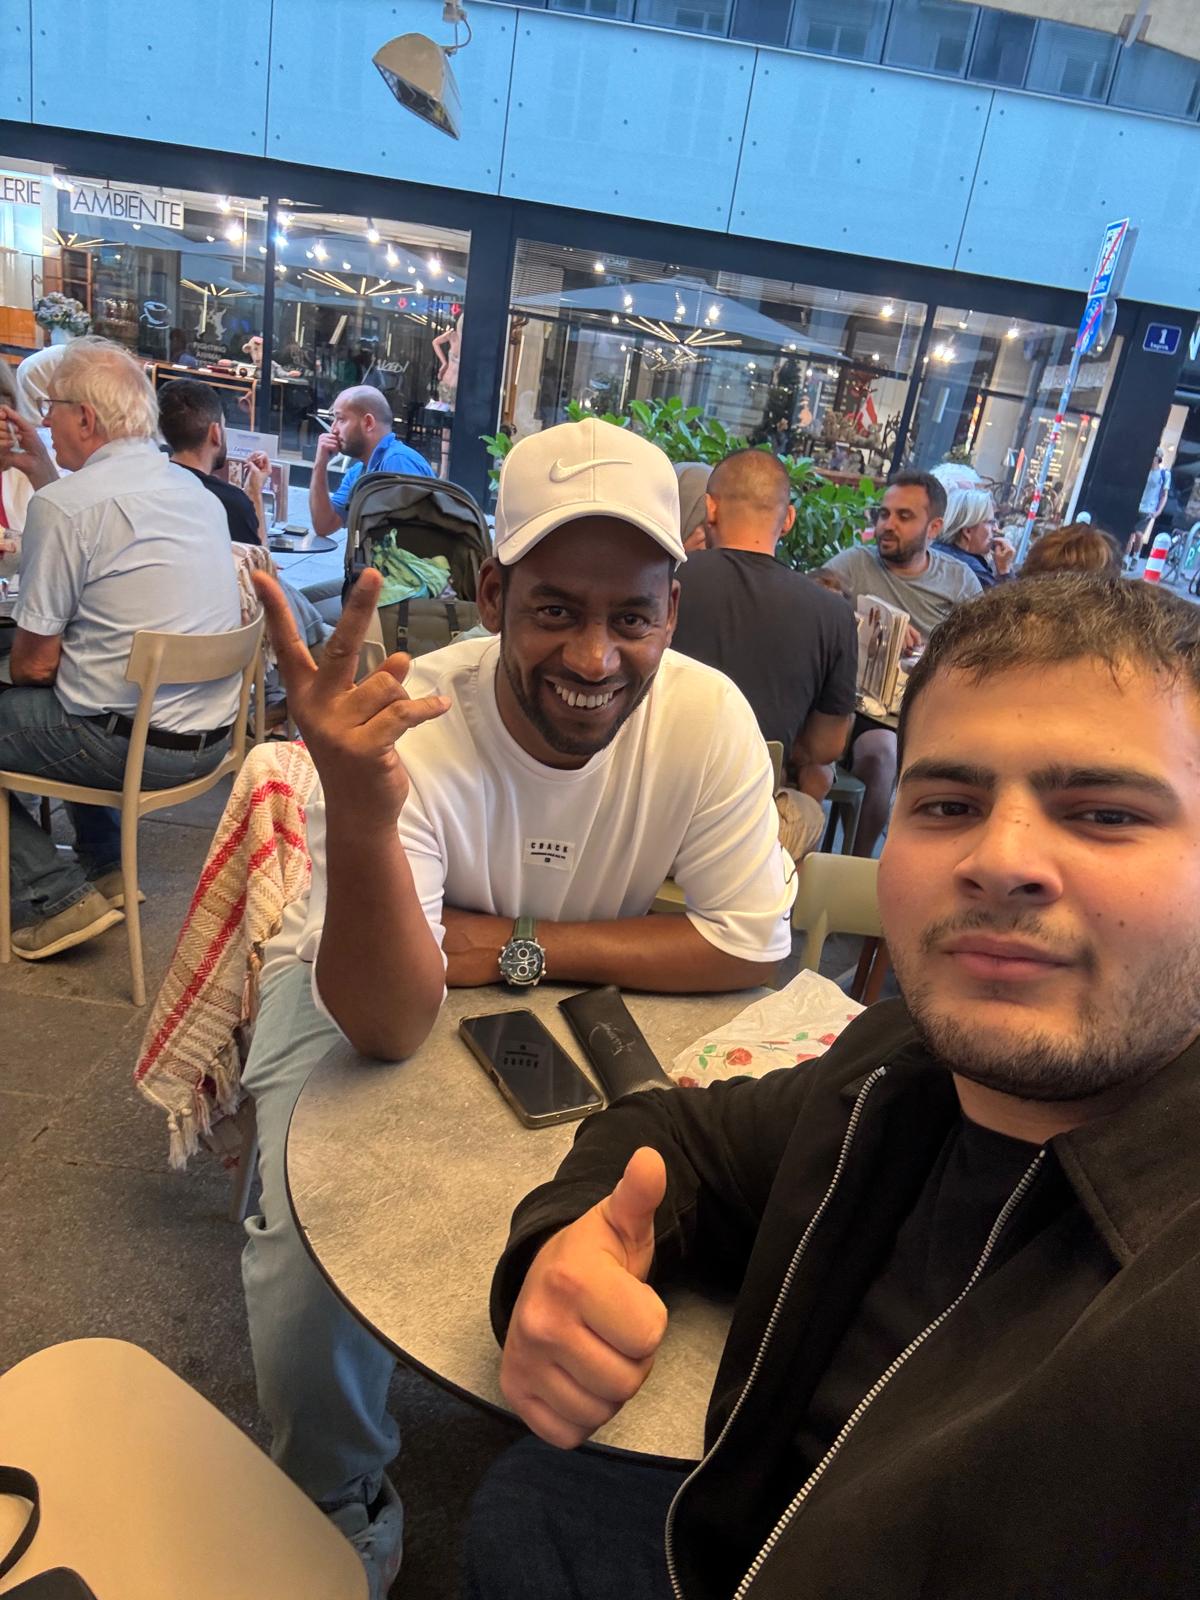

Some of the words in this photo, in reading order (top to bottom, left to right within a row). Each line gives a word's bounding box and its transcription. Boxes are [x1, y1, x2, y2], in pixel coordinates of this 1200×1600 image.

[0, 177, 41, 205] ERIE
[73, 188, 185, 227] AMBIENTE
[1159, 328, 1168, 345] 1
